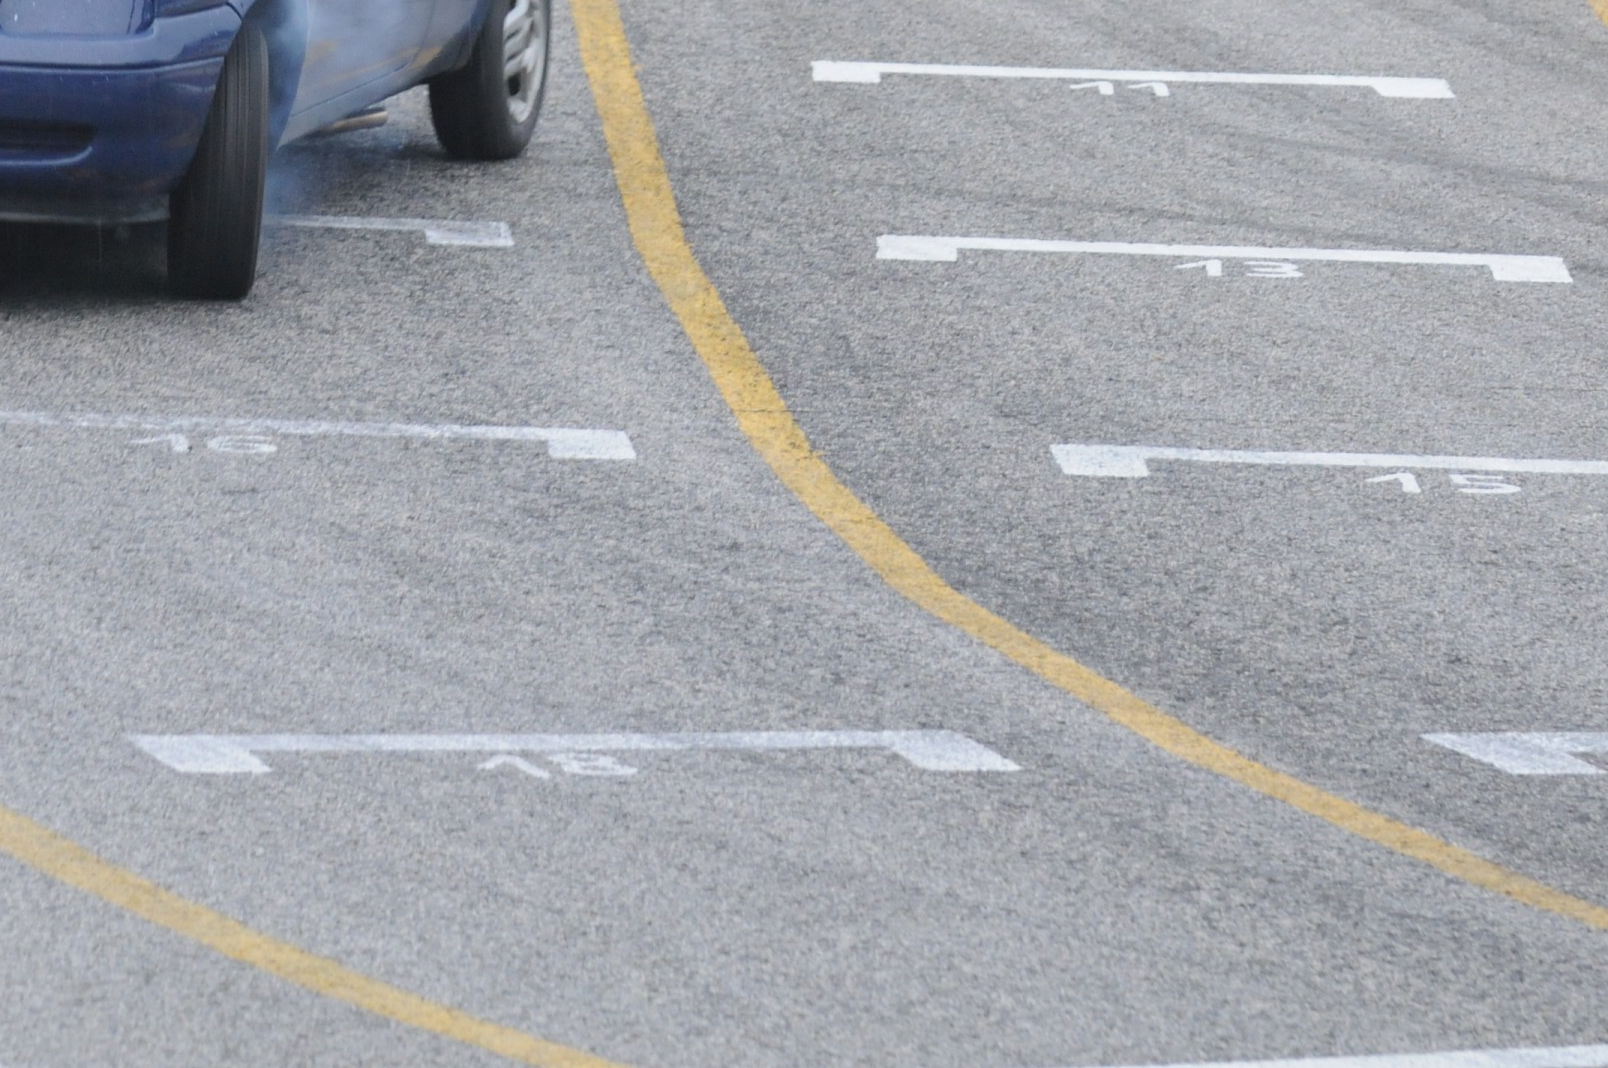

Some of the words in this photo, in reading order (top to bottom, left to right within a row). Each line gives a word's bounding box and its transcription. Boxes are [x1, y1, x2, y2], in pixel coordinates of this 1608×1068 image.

[1069, 80, 1171, 98] 11
[1173, 258, 1304, 278] 13
[130, 433, 278, 454] 16
[1364, 472, 1524, 495] 15
[477, 753, 639, 780] 18
